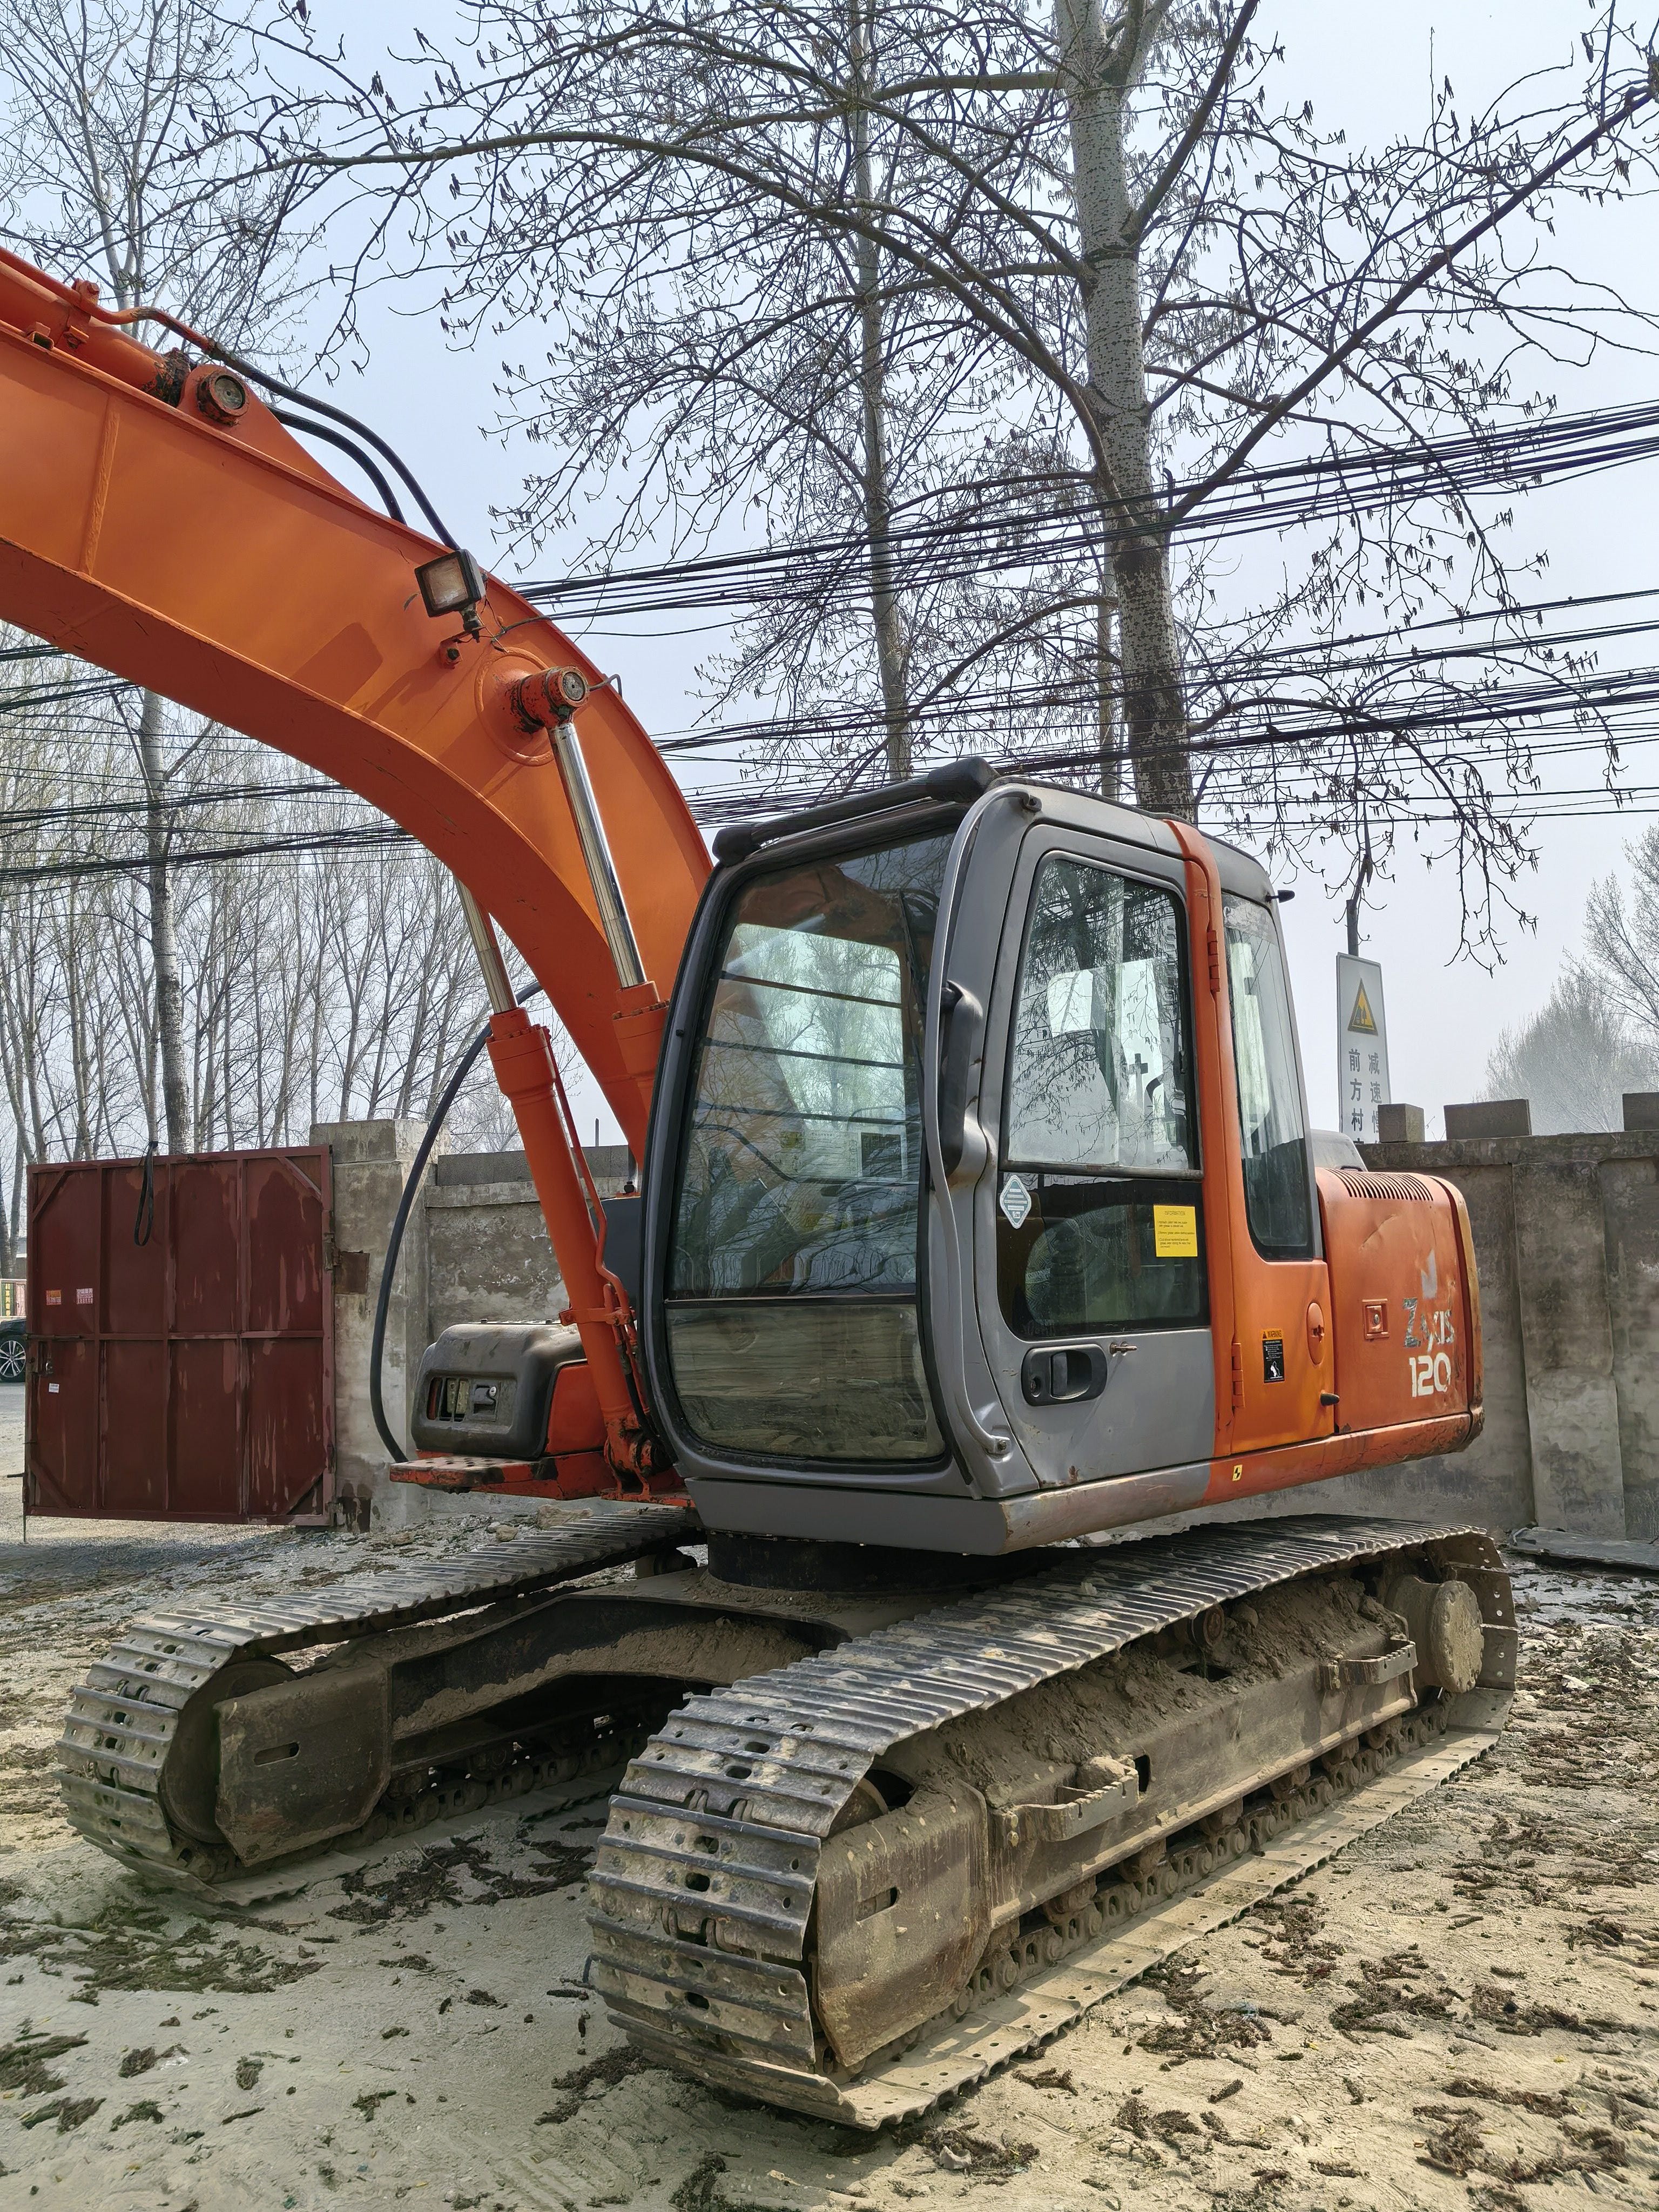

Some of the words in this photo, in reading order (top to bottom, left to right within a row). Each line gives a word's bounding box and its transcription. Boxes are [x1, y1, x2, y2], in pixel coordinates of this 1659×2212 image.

[1349, 1048, 1364, 1144] 前方村
[1368, 1053, 1382, 1144] 减速慢
[1408, 1352, 1452, 1398] 120
